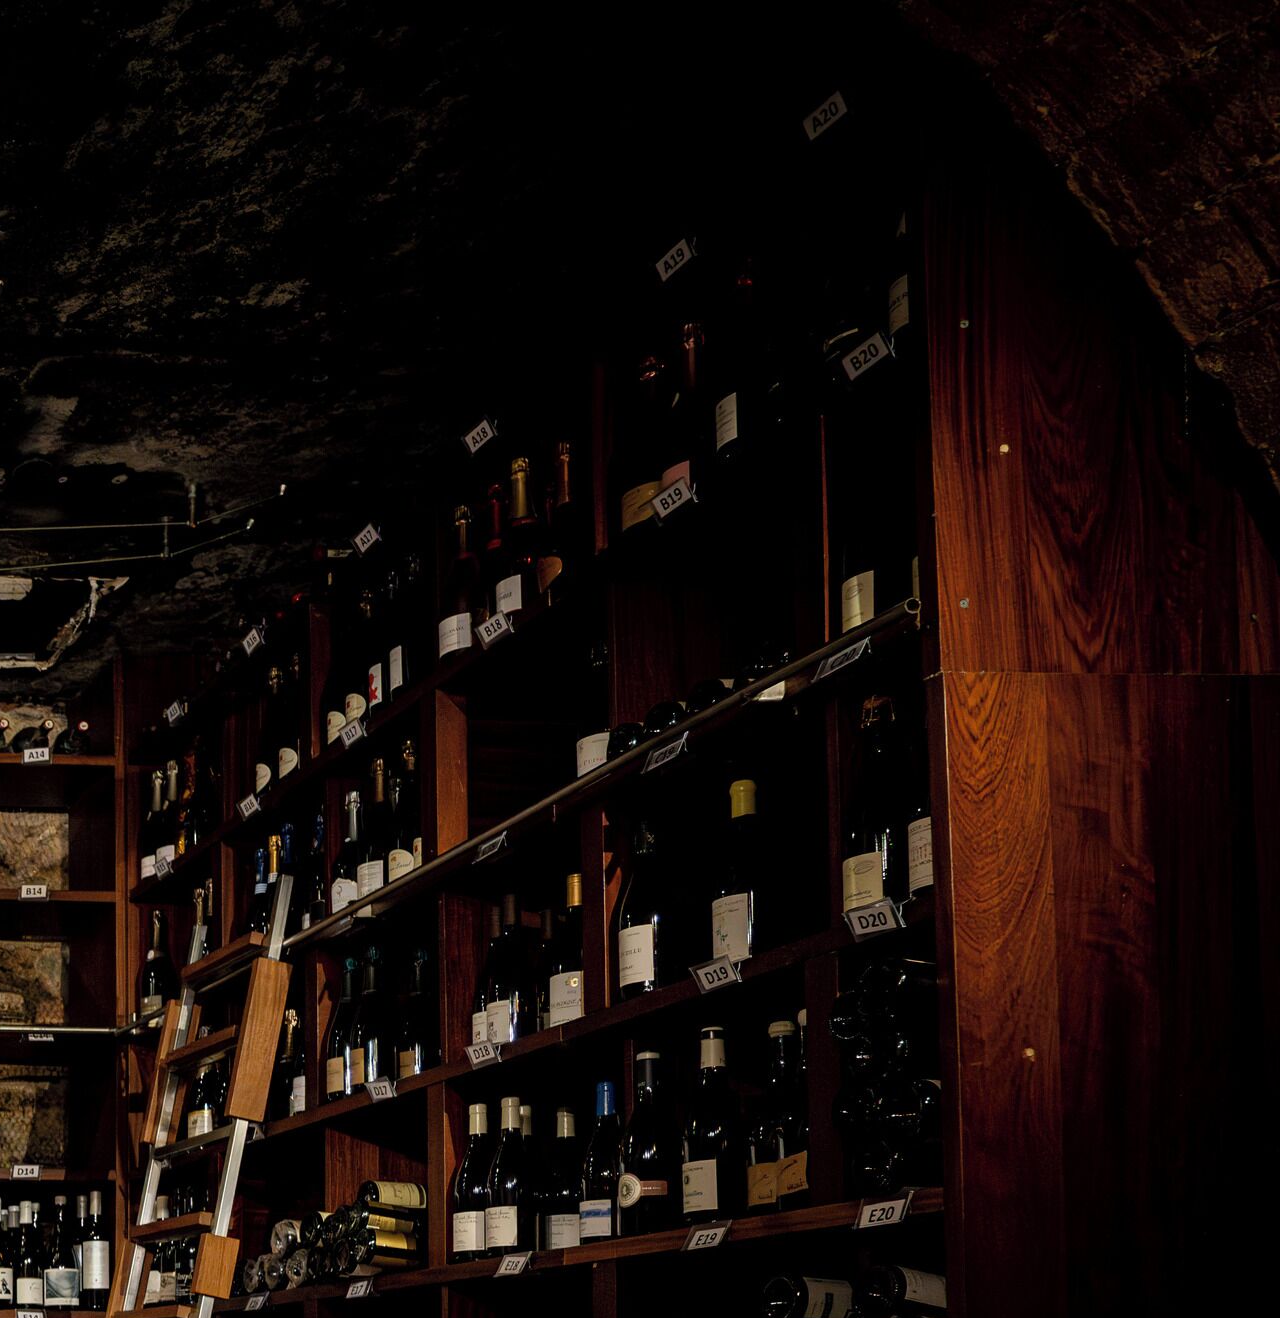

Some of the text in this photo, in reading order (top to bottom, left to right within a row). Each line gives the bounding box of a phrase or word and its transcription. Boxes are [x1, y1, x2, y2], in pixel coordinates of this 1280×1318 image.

[812, 101, 839, 133] A20
[663, 248, 685, 274] A19
[850, 343, 879, 372] B20
[472, 427, 488, 447] A18
[660, 487, 683, 511] B19
[360, 530, 373, 547] A17
[484, 619, 502, 637] B18
[345, 725, 357, 741] B17
[29, 751, 44, 759] A14
[26, 887, 42, 895] B14
[857, 910, 887, 929] D20
[704, 966, 729, 984] D19
[473, 1045, 490, 1060] D18
[373, 1085, 387, 1096] D17
[868, 1206, 895, 1223] E20
[695, 1233, 717, 1246] E19
[504, 1260, 518, 1271] E18
[352, 1285, 363, 1295] E17
